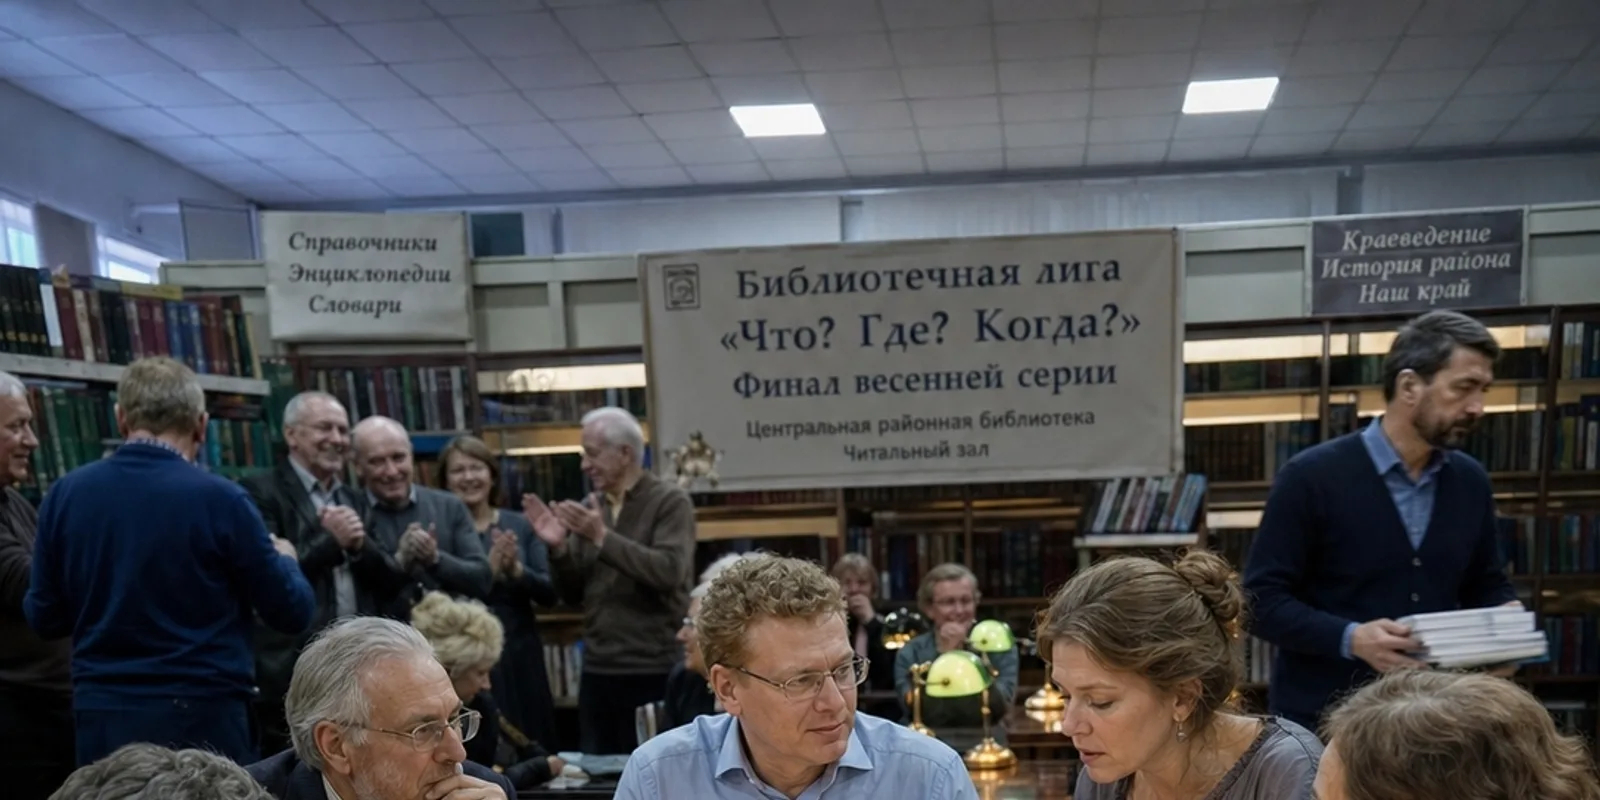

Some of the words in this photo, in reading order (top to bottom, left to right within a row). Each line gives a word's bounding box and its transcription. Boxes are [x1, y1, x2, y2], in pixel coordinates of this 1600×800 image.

[288, 231, 437, 256] Справочники
[1342, 225, 1491, 255] Краеведение
[288, 263, 452, 287] Энциклопедии
[736, 264, 1020, 299] Библиотечная
[1036, 259, 1121, 285] лига
[1321, 258, 1423, 281] История
[1428, 251, 1511, 278] района
[309, 294, 402, 319] Словари
[1359, 283, 1410, 304] Наш
[1417, 278, 1471, 305] край
[720, 316, 835, 351] «Что?
[859, 311, 949, 353] Где?
[974, 303, 1141, 346] Когда?»
[733, 371, 841, 399] Финал
[855, 363, 1004, 394] весенней
[1018, 364, 1117, 395] серии
[746, 419, 872, 442] Центральная
[878, 414, 973, 437] районная
[979, 410, 1095, 430] библиотека
[844, 440, 951, 461] Читальный
[956, 443, 989, 458] зал
